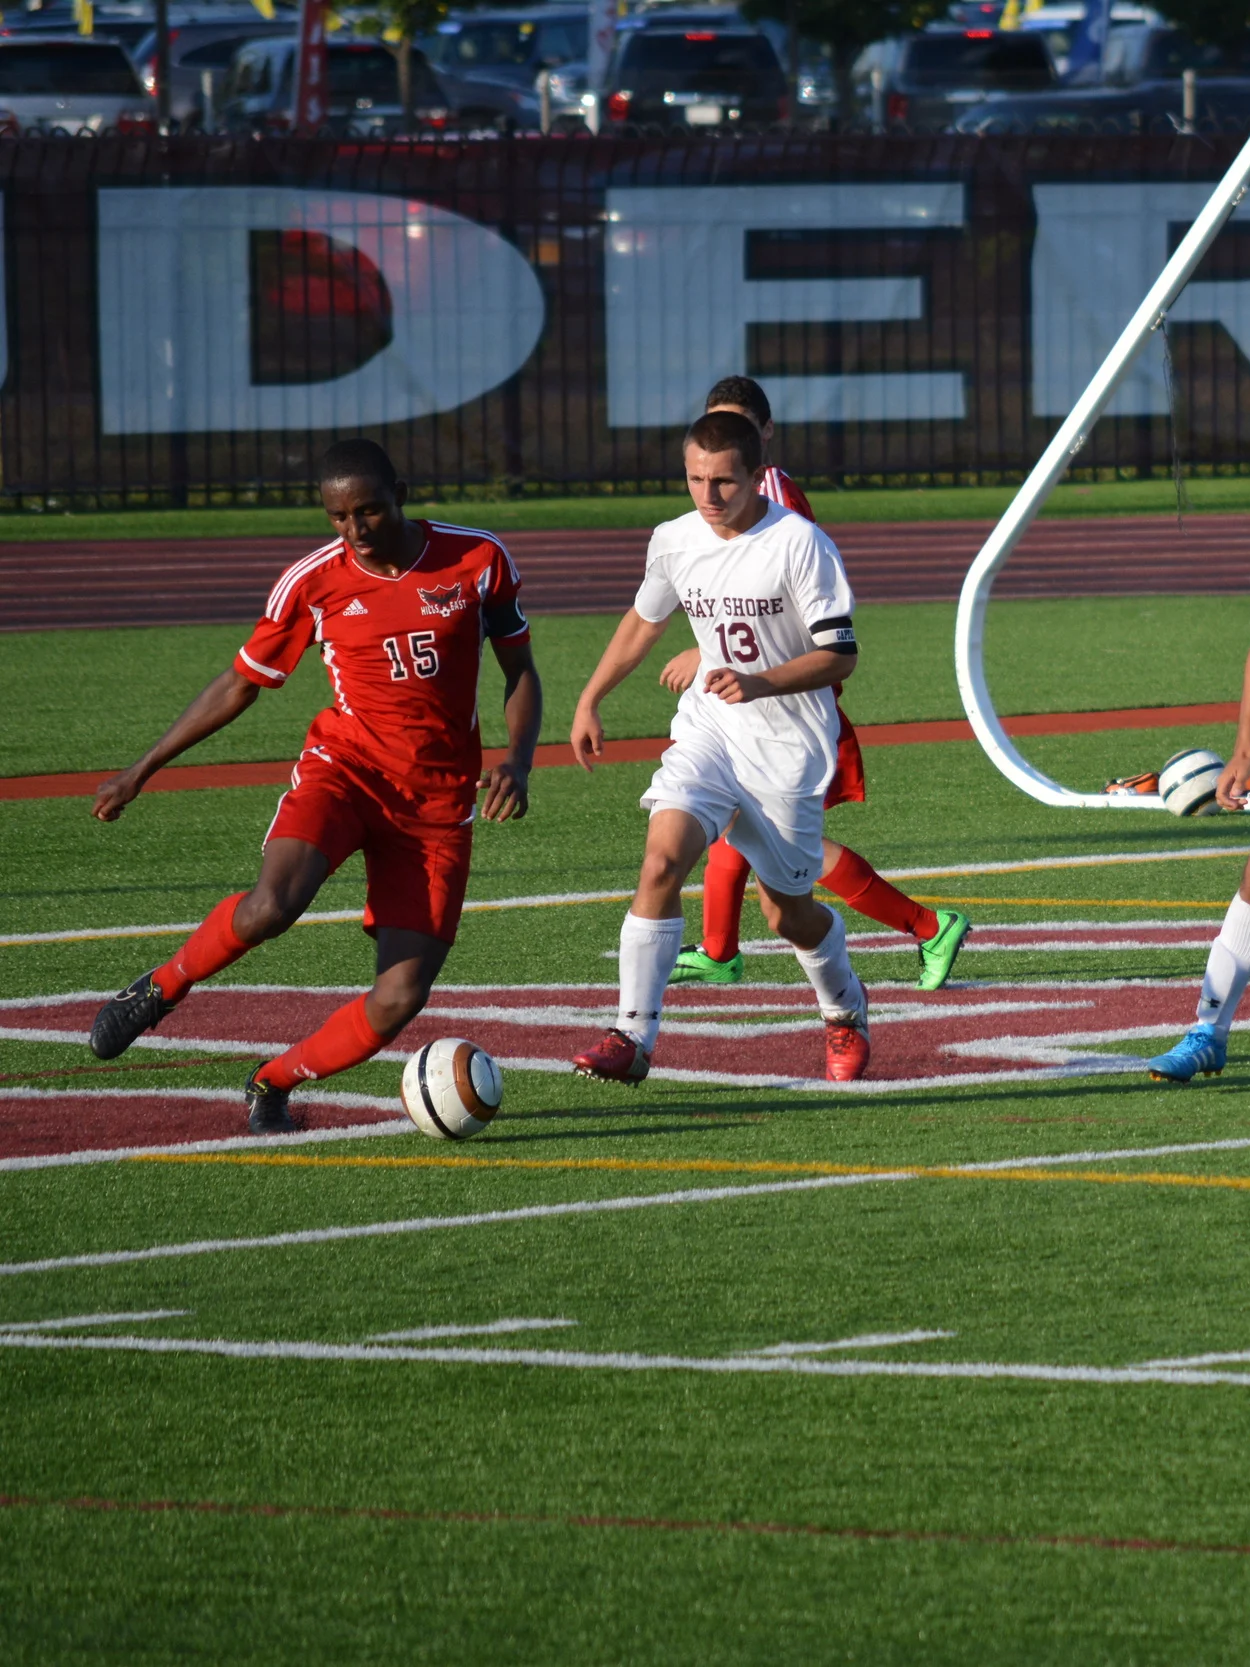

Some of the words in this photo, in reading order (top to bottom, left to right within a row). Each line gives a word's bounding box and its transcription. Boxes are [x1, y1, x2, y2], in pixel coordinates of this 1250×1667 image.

[343, 608, 368, 616] adidas
[421, 604, 440, 615] HILLS
[450, 600, 466, 611] EAST
[684, 598, 716, 618] BAY
[723, 596, 784, 617] SHORE
[714, 622, 761, 664] 13
[383, 631, 439, 681] 15
